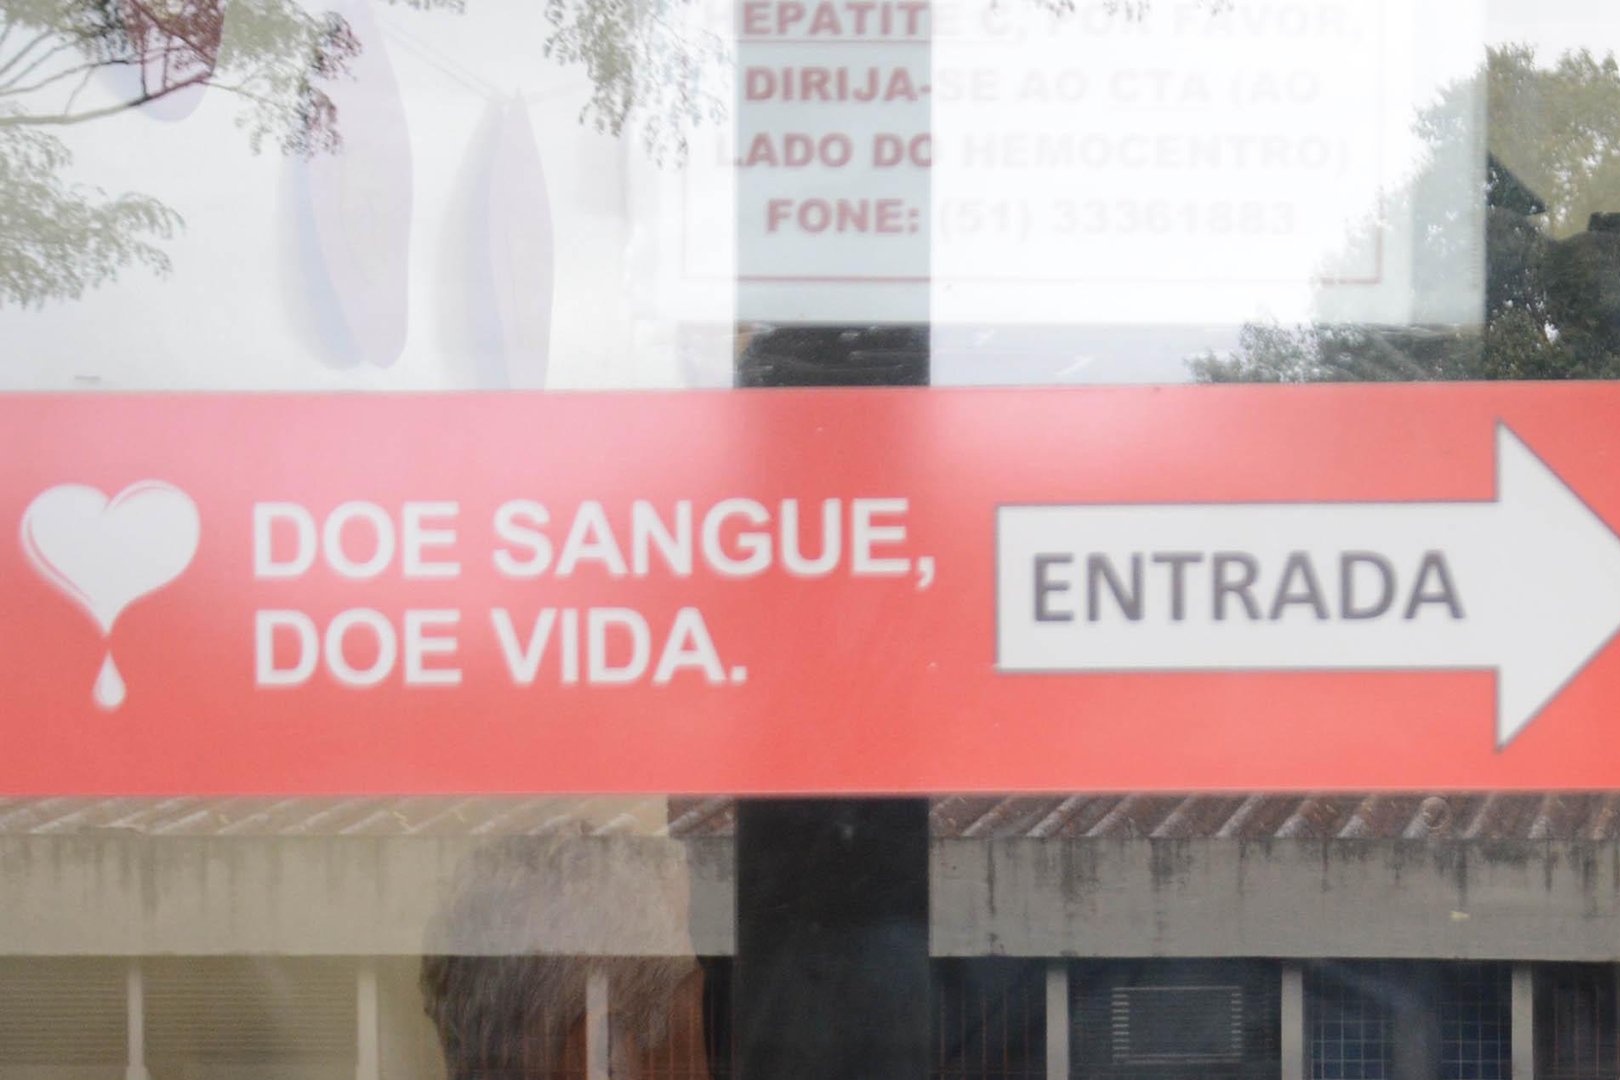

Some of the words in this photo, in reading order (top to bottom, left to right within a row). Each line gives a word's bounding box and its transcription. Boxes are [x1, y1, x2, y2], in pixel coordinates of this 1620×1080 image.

[744, 66, 999, 103] DIRIJA-SE
[1018, 67, 1088, 103] AO
[1107, 67, 1212, 104] CTA
[1230, 66, 1321, 110] (AO
[715, 132, 854, 169] LADO
[873, 133, 938, 169] DO
[963, 132, 1353, 178] HEMOCENTRO)
[765, 198, 920, 236] FONE:
[939, 199, 1032, 244] (51)
[254, 502, 462, 578] DOE
[492, 497, 937, 589] SANGUE,
[1032, 549, 1466, 623] ENTRADA
[255, 609, 463, 688] DOE
[491, 608, 750, 686] VIDA.
